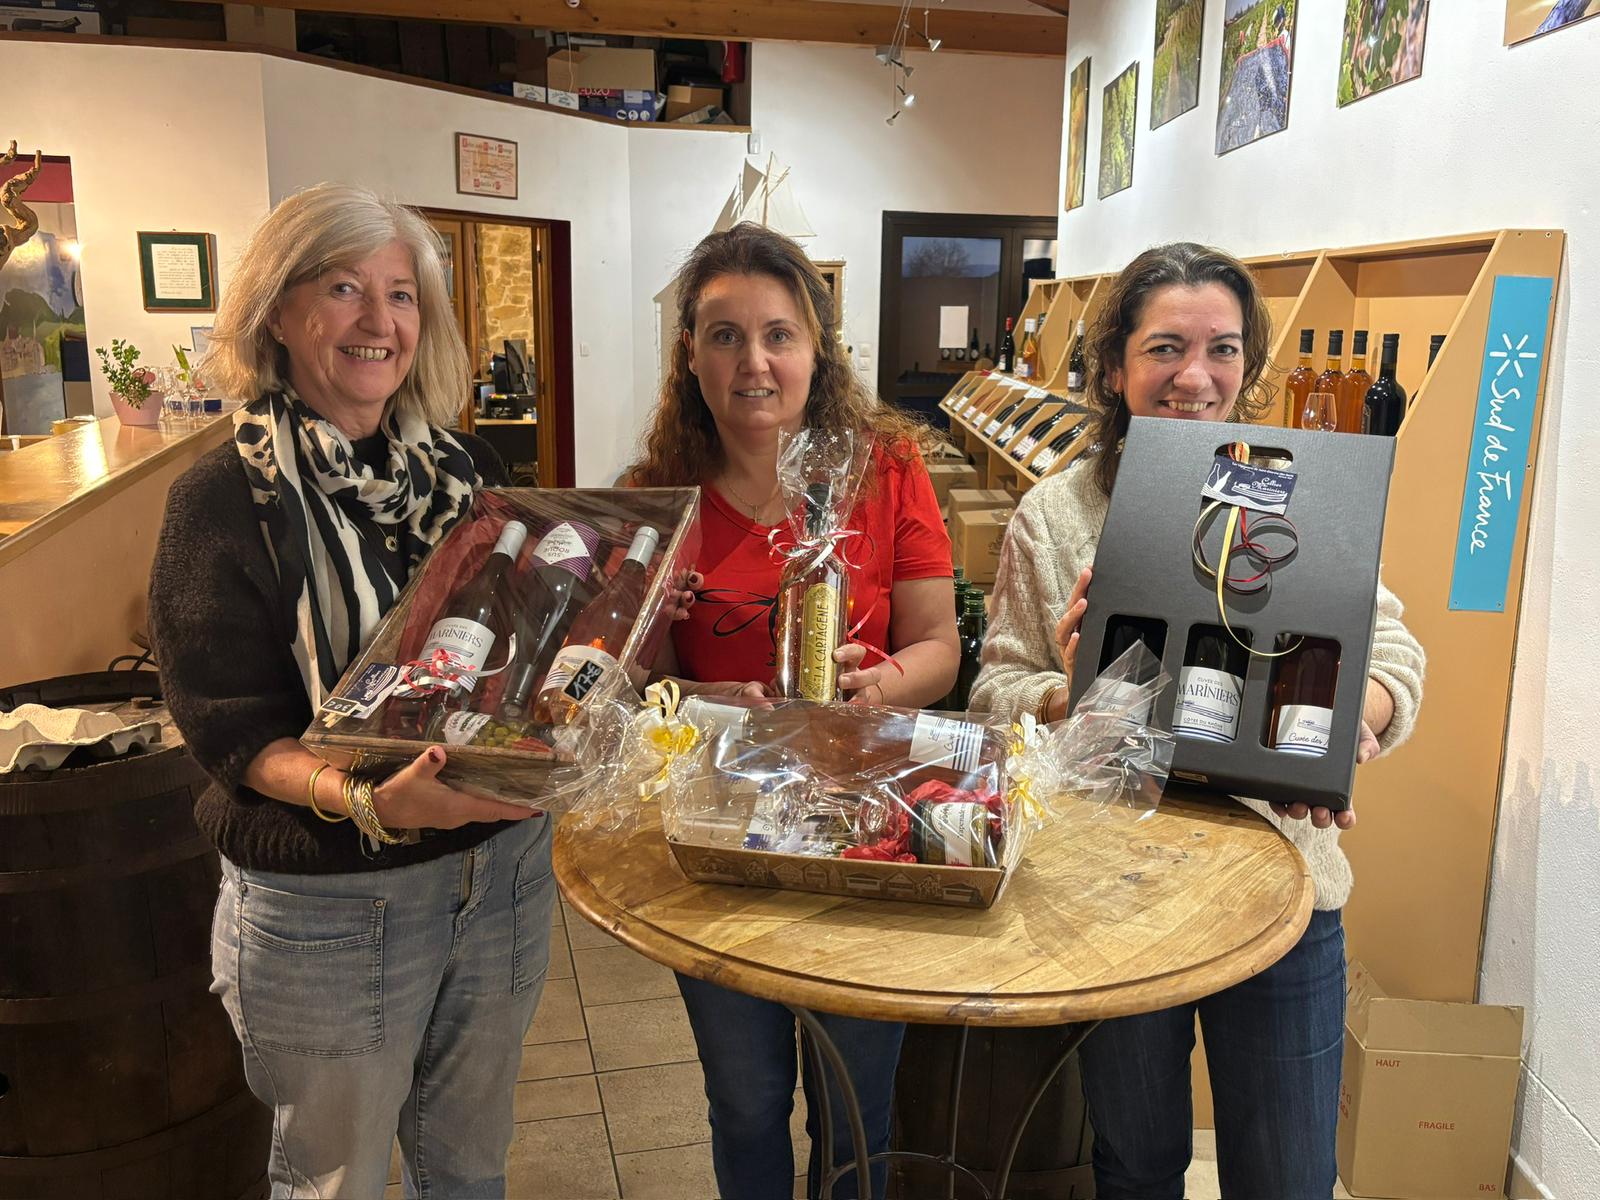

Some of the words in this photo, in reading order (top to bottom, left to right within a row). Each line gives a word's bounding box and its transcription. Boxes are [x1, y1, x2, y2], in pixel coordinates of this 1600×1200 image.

[1484, 378, 1521, 432] Sud
[1483, 434, 1508, 467] de
[1470, 470, 1512, 555] France
[813, 665, 826, 680] LA
[1178, 683, 1239, 706] MARINIERS
[1375, 1058, 1401, 1068] HAUT
[1418, 1120, 1455, 1131] FRAGILE
[1478, 1183, 1496, 1192] BAS
